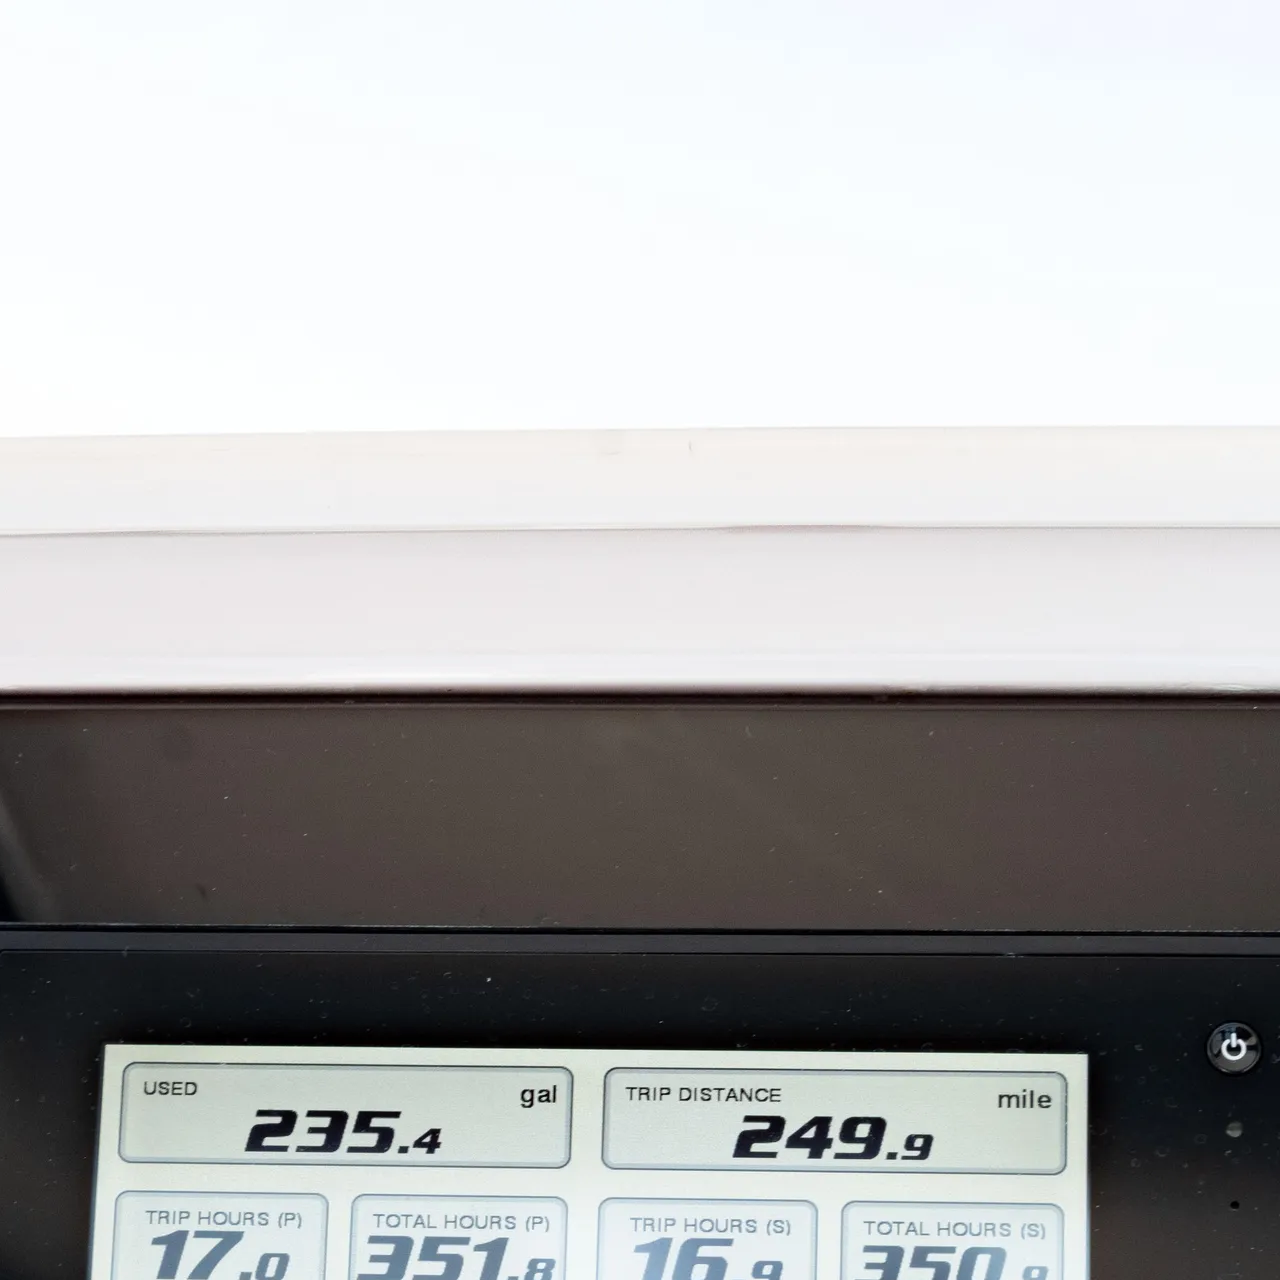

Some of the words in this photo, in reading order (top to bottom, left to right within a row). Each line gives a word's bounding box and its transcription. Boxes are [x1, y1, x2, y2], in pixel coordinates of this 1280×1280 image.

[143, 1081, 198, 1096] USED
[520, 1085, 557, 1108] gal
[625, 1087, 671, 1102] TRIP
[679, 1087, 782, 1103] DISTANCE
[998, 1088, 1052, 1109] mile
[244, 1109, 442, 1154] 235.4
[732, 1115, 934, 1161] 249.9
[146, 1210, 190, 1226] TRIP
[198, 1211, 269, 1227] HOURS
[277, 1212, 303, 1229] (P)
[373, 1213, 437, 1229] TOTAL
[444, 1214, 517, 1231] HOURS
[525, 1215, 550, 1233] (P)
[630, 1217, 677, 1233] TRIP
[684, 1218, 758, 1234] HOURS
[766, 1219, 791, 1237] (S)
[863, 1220, 930, 1237] TOTAL
[937, 1221, 1012, 1238] HOURS
[1021, 1222, 1046, 1241] (S)
